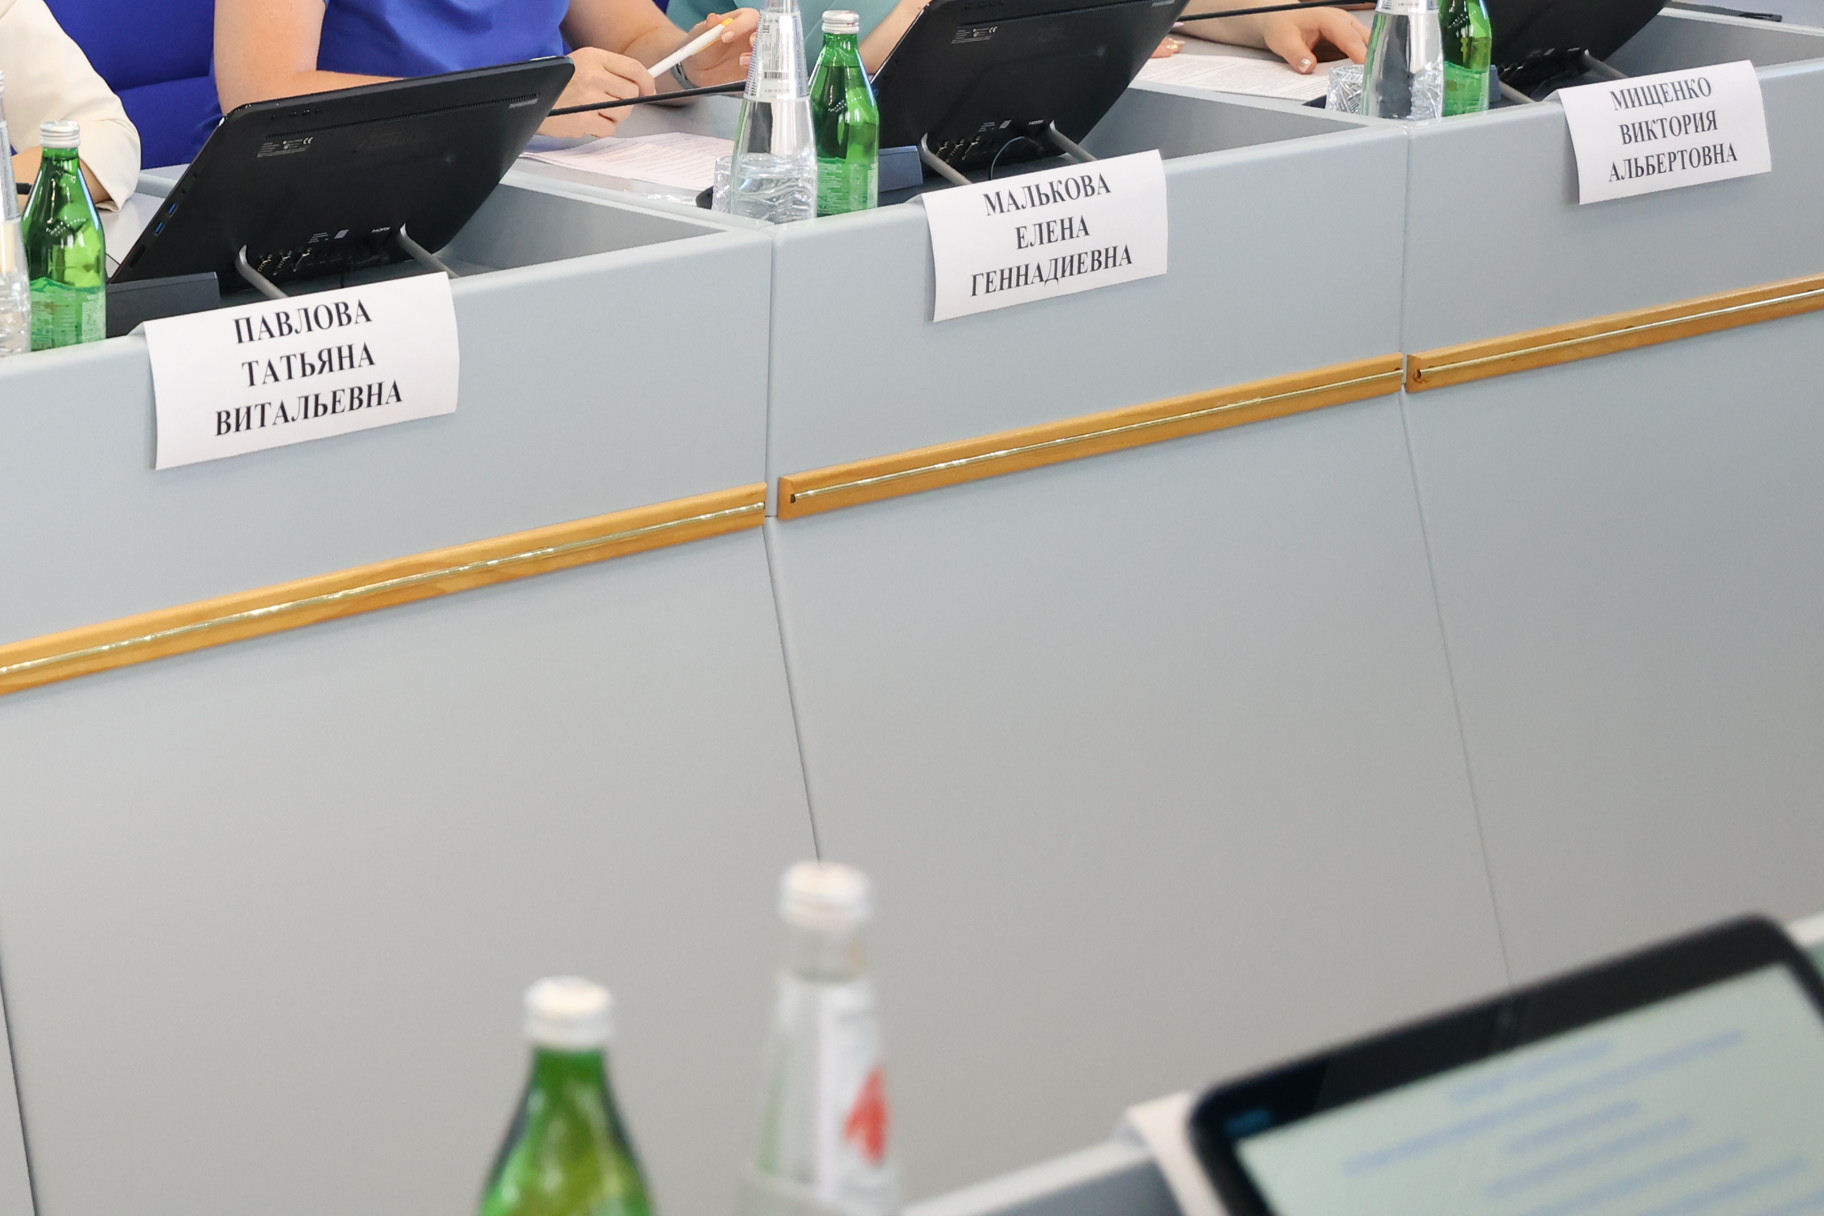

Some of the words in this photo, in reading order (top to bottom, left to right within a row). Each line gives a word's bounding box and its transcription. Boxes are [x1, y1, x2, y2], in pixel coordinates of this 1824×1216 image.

[1609, 77, 1712, 111] МИЩЕНКО
[1619, 109, 1718, 145] ВИКТОРИЯ
[1608, 143, 1738, 183] АЛЬБЕРТОВНА
[983, 173, 1112, 216] МАЛЬКОВА
[1015, 215, 1090, 250] ЕЛЕНА
[971, 244, 1133, 297] ГЕННАДИЕВНА
[234, 299, 372, 344] ПАВЛОВА
[241, 342, 375, 387] ТАТЬЯНА
[216, 380, 403, 437] ВИТАЛЬЕВНА
